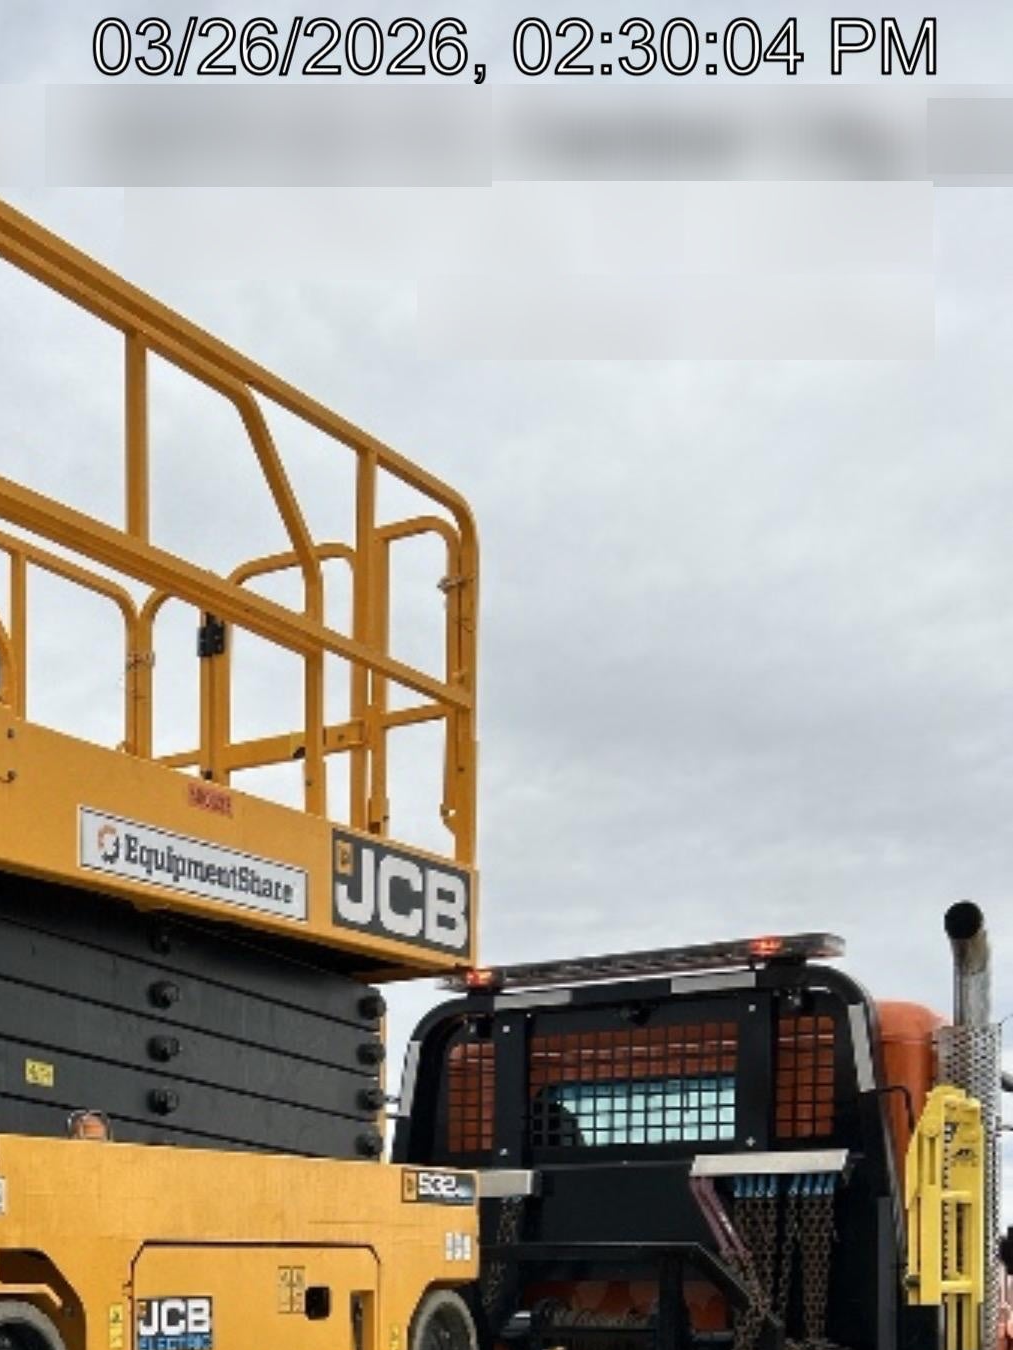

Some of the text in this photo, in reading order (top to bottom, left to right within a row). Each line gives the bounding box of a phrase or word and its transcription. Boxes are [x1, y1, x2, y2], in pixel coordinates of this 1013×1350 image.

[124, 833, 294, 904] EquipmentShare
[335, 848, 468, 949] JCB
[139, 1298, 210, 1336] JCB
